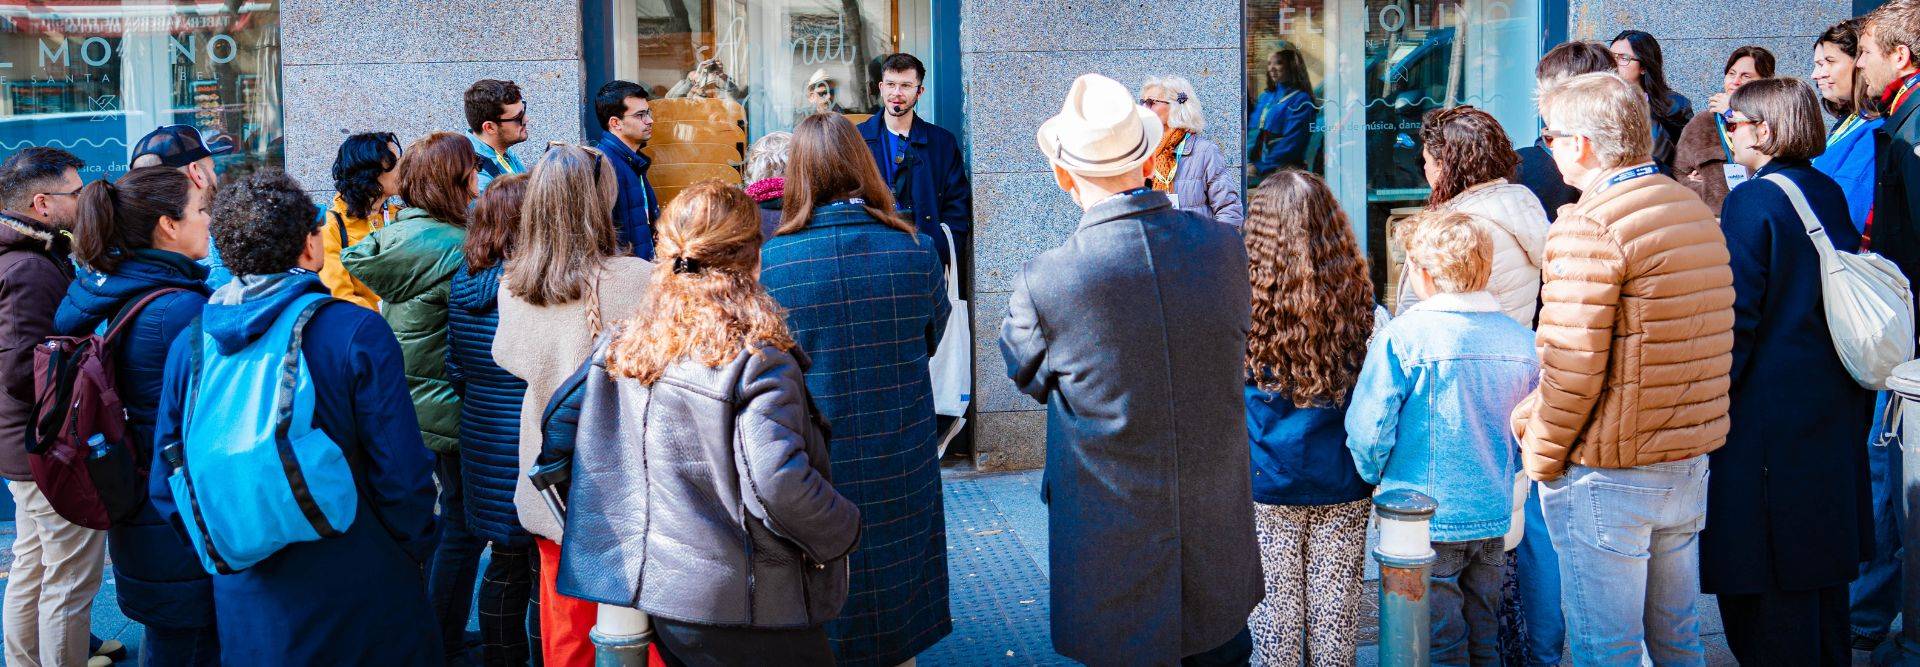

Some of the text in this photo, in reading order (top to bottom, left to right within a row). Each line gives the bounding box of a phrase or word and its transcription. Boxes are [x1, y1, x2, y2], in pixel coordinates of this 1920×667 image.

[1279, 7, 1323, 35] EL
[39, 34, 238, 68] MONO
[31, 74, 111, 85] SANTA
[1399, 118, 1422, 130] danz
[108, 161, 128, 172] dan
